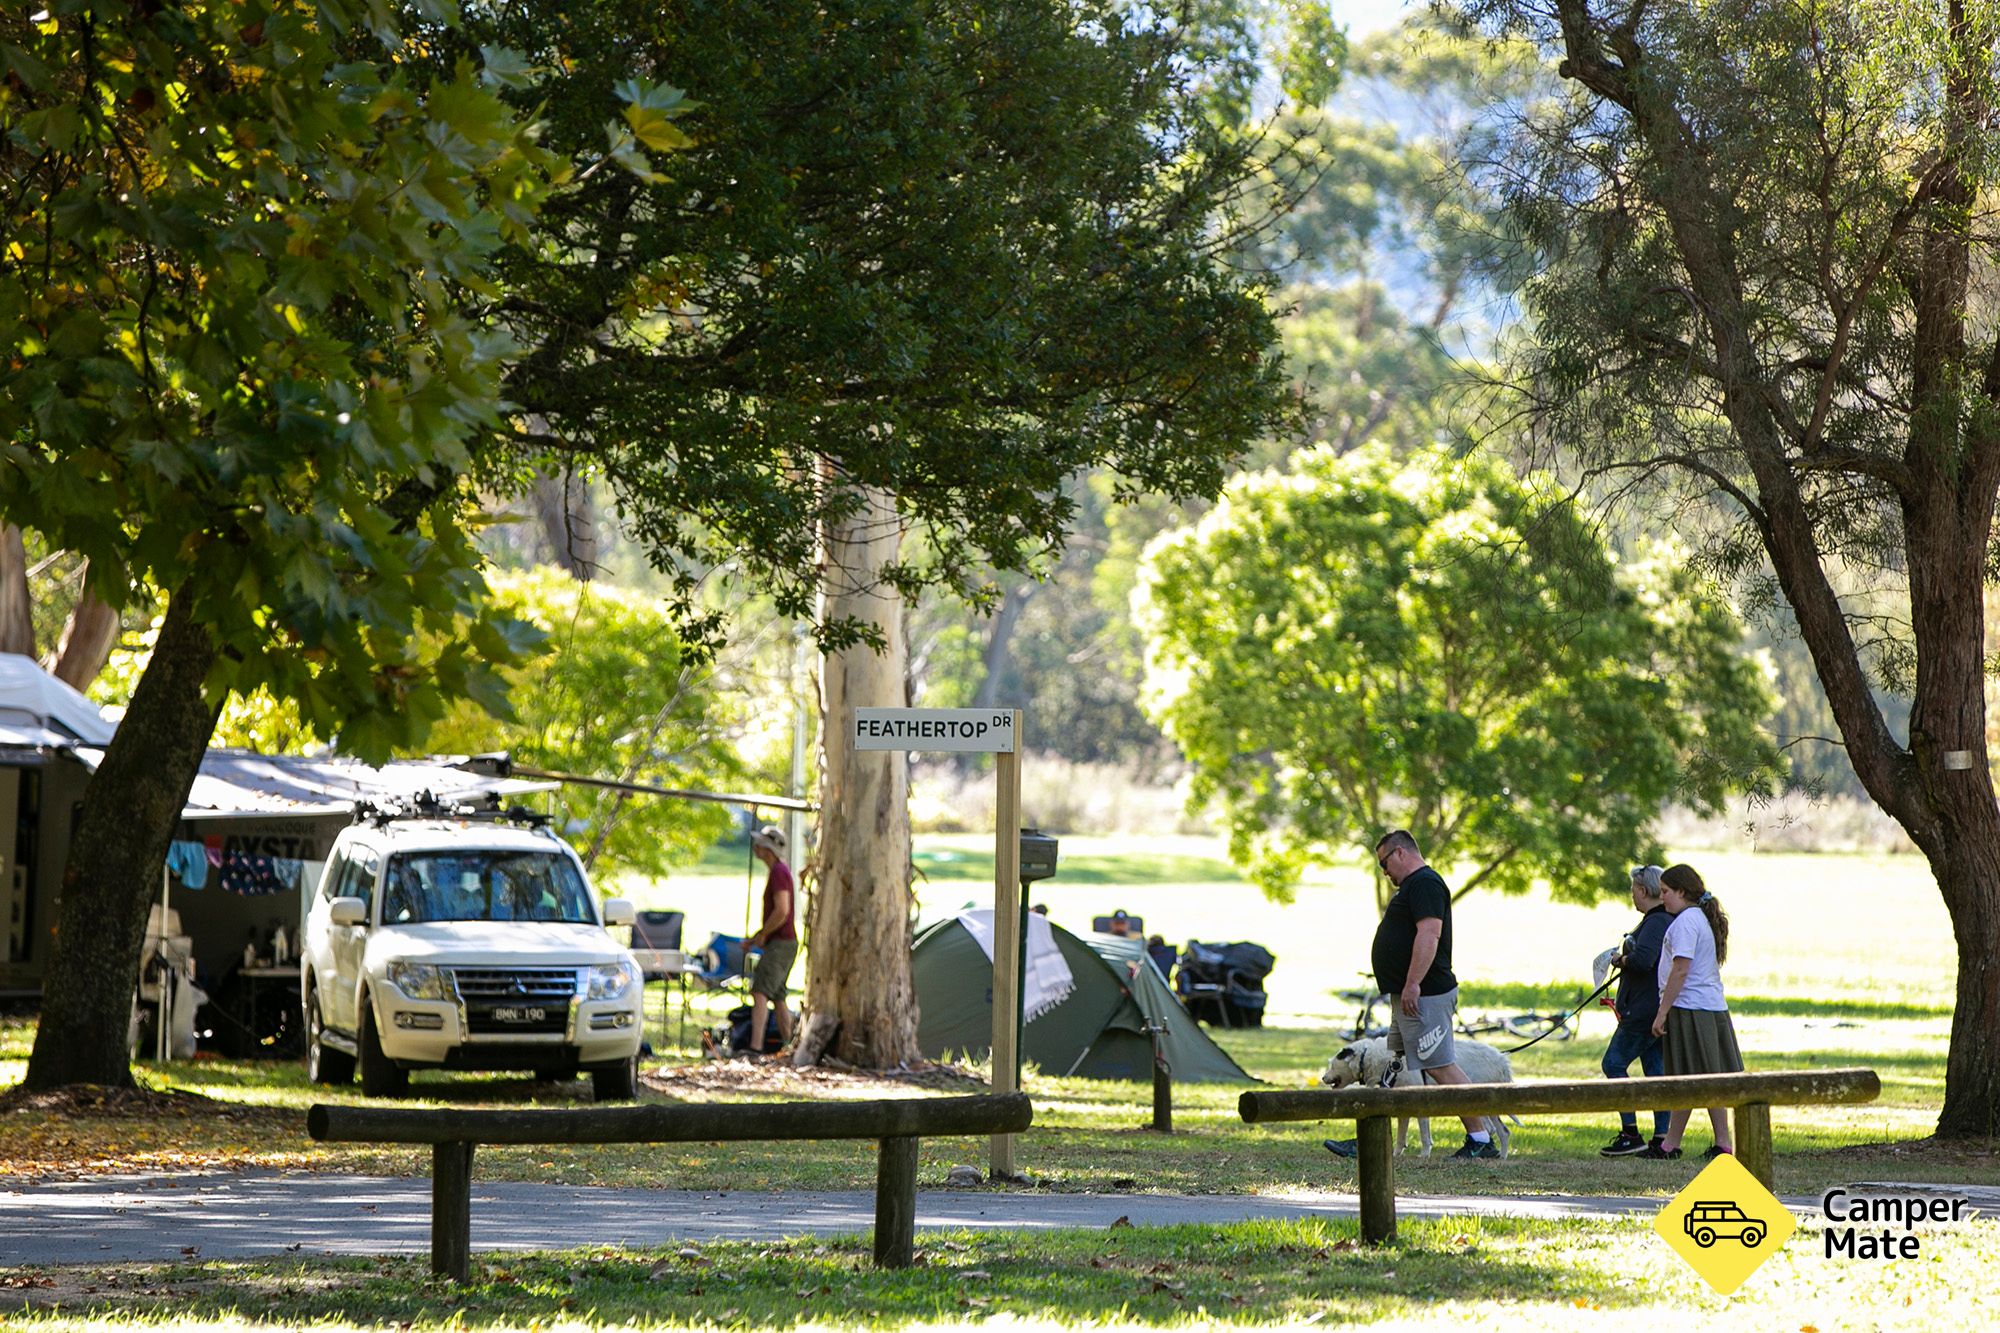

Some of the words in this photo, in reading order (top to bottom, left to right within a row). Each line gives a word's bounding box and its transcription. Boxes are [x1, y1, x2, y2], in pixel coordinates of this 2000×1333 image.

[857, 720, 988, 738] FEATHERTOP
[992, 715, 1012, 728] DR
[1418, 1025, 1442, 1051] NIKE
